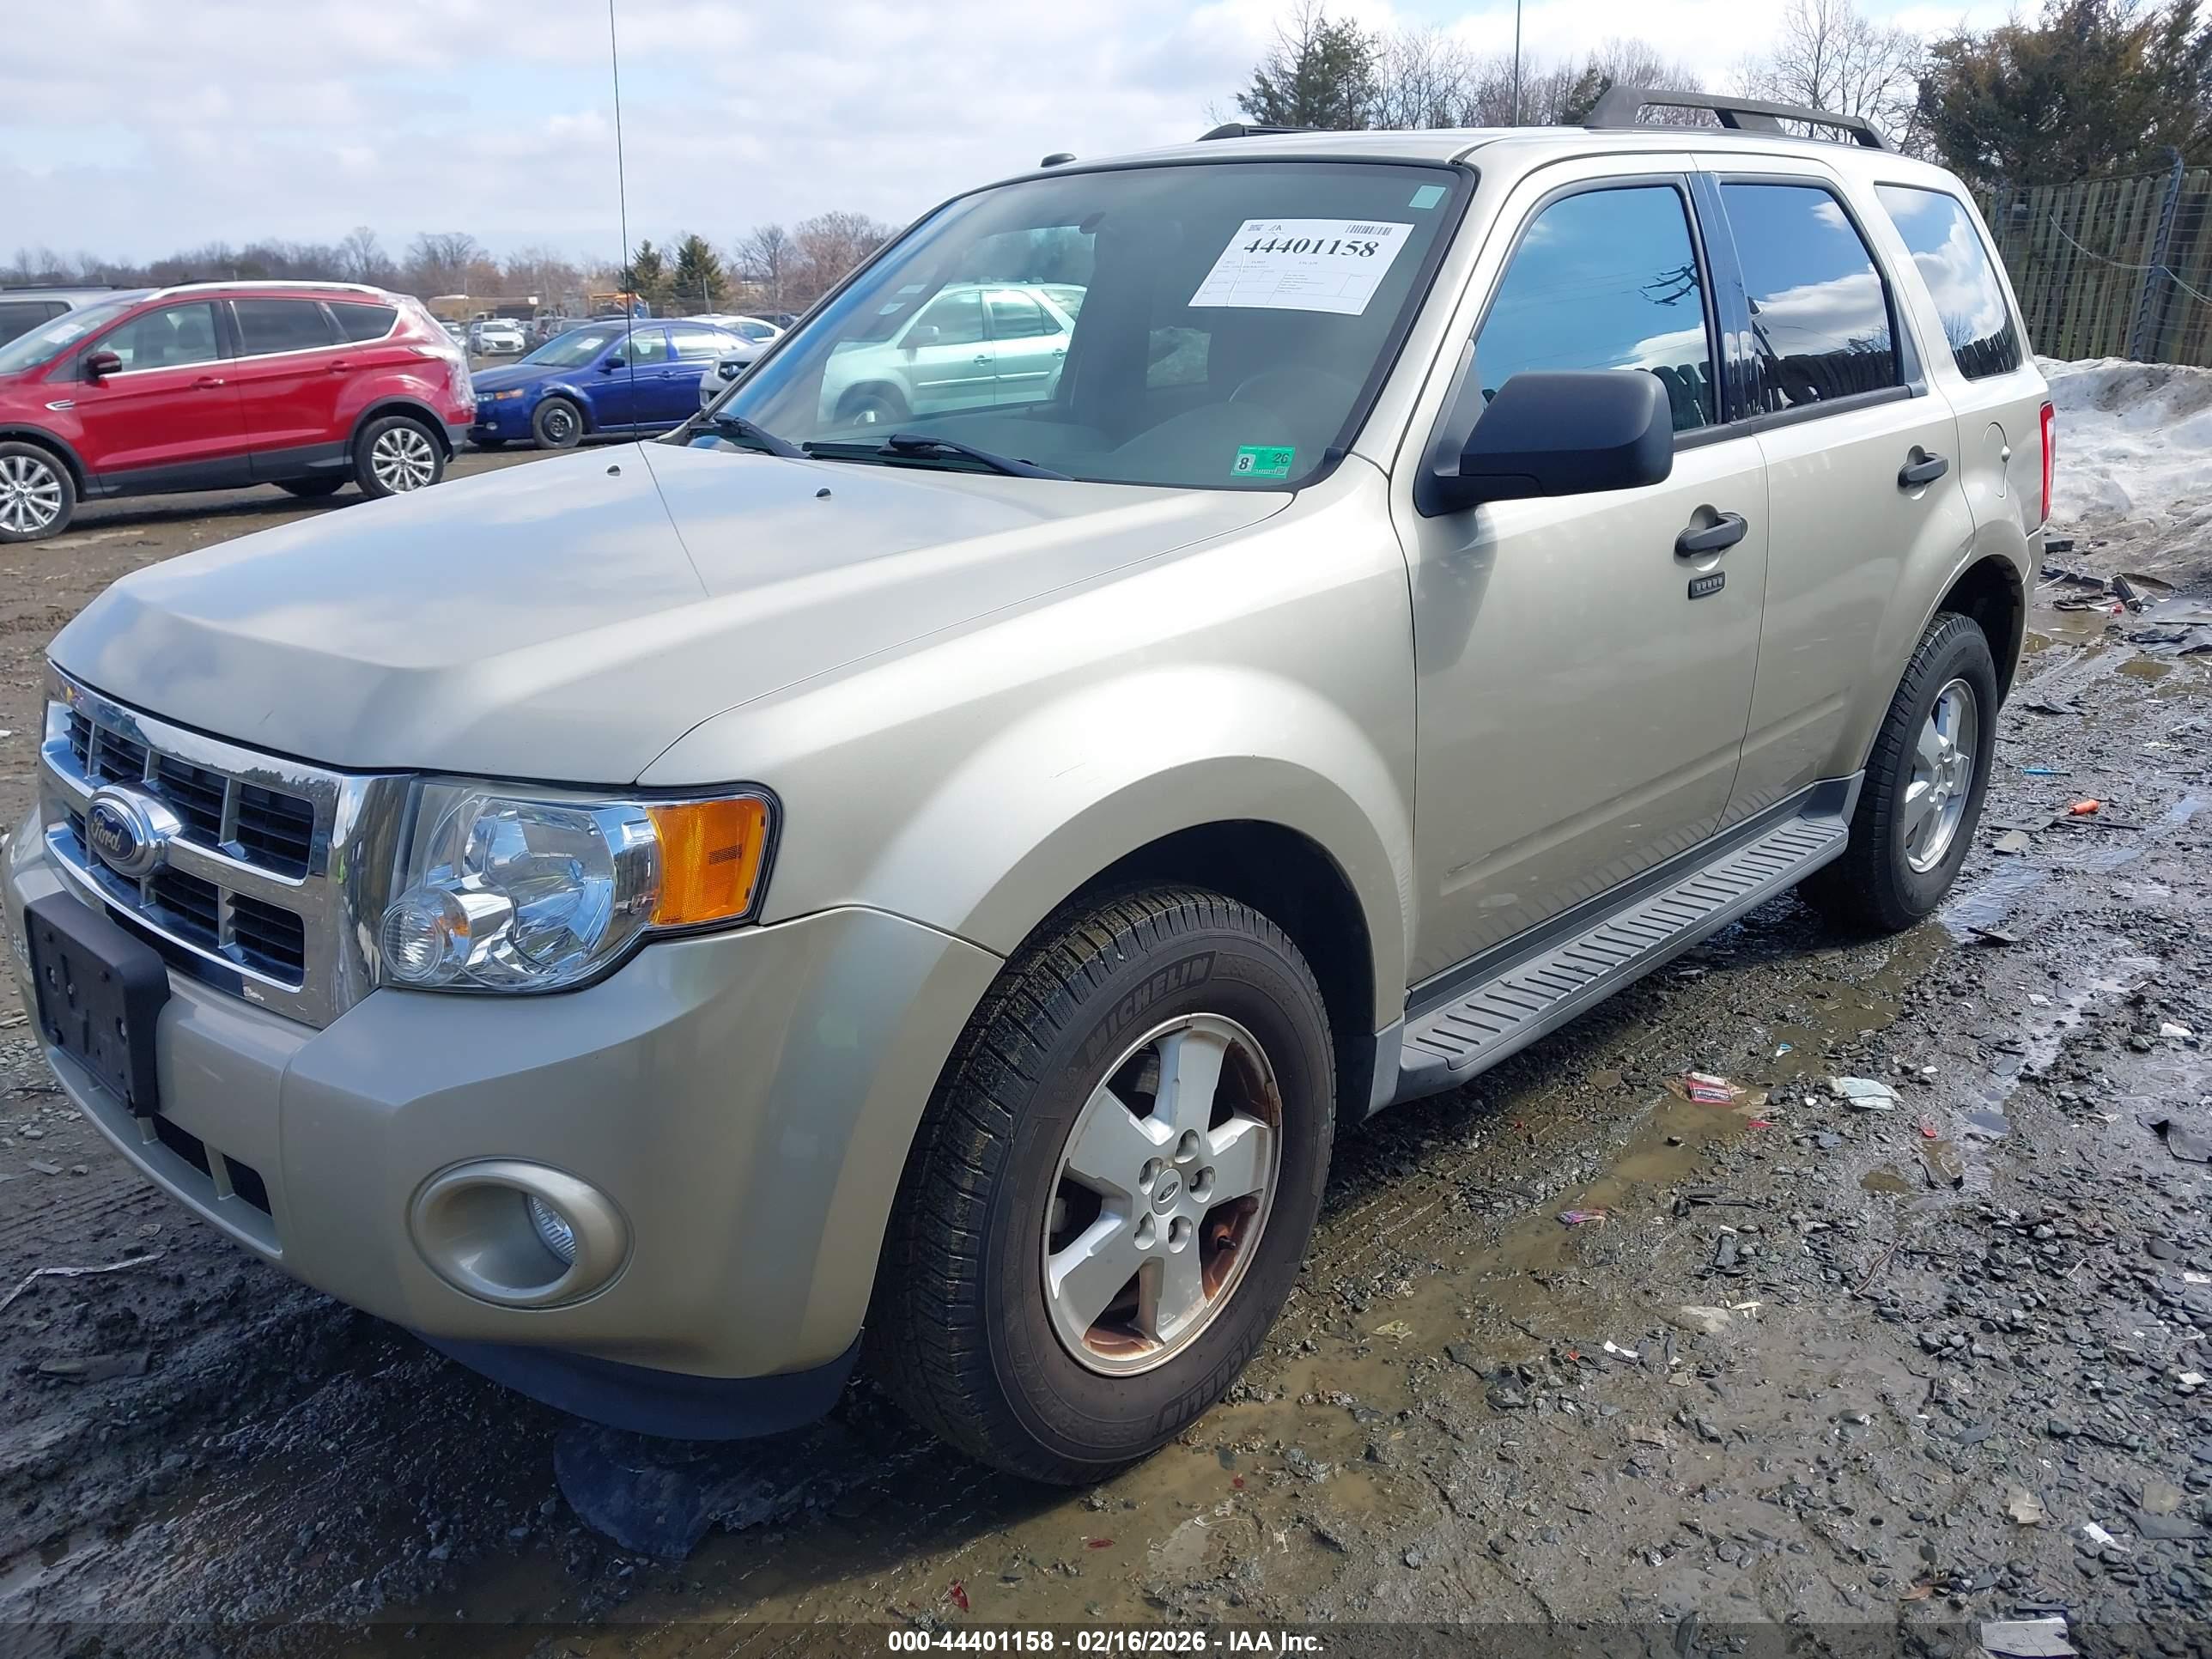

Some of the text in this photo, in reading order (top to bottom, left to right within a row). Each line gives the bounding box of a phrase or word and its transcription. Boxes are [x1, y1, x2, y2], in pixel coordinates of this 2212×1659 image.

[1243, 238, 1380, 258] 44401158
[1238, 457, 1249, 470] 8
[90, 808, 122, 852] Ford
[1085, 956, 1211, 1064] MICHELIN
